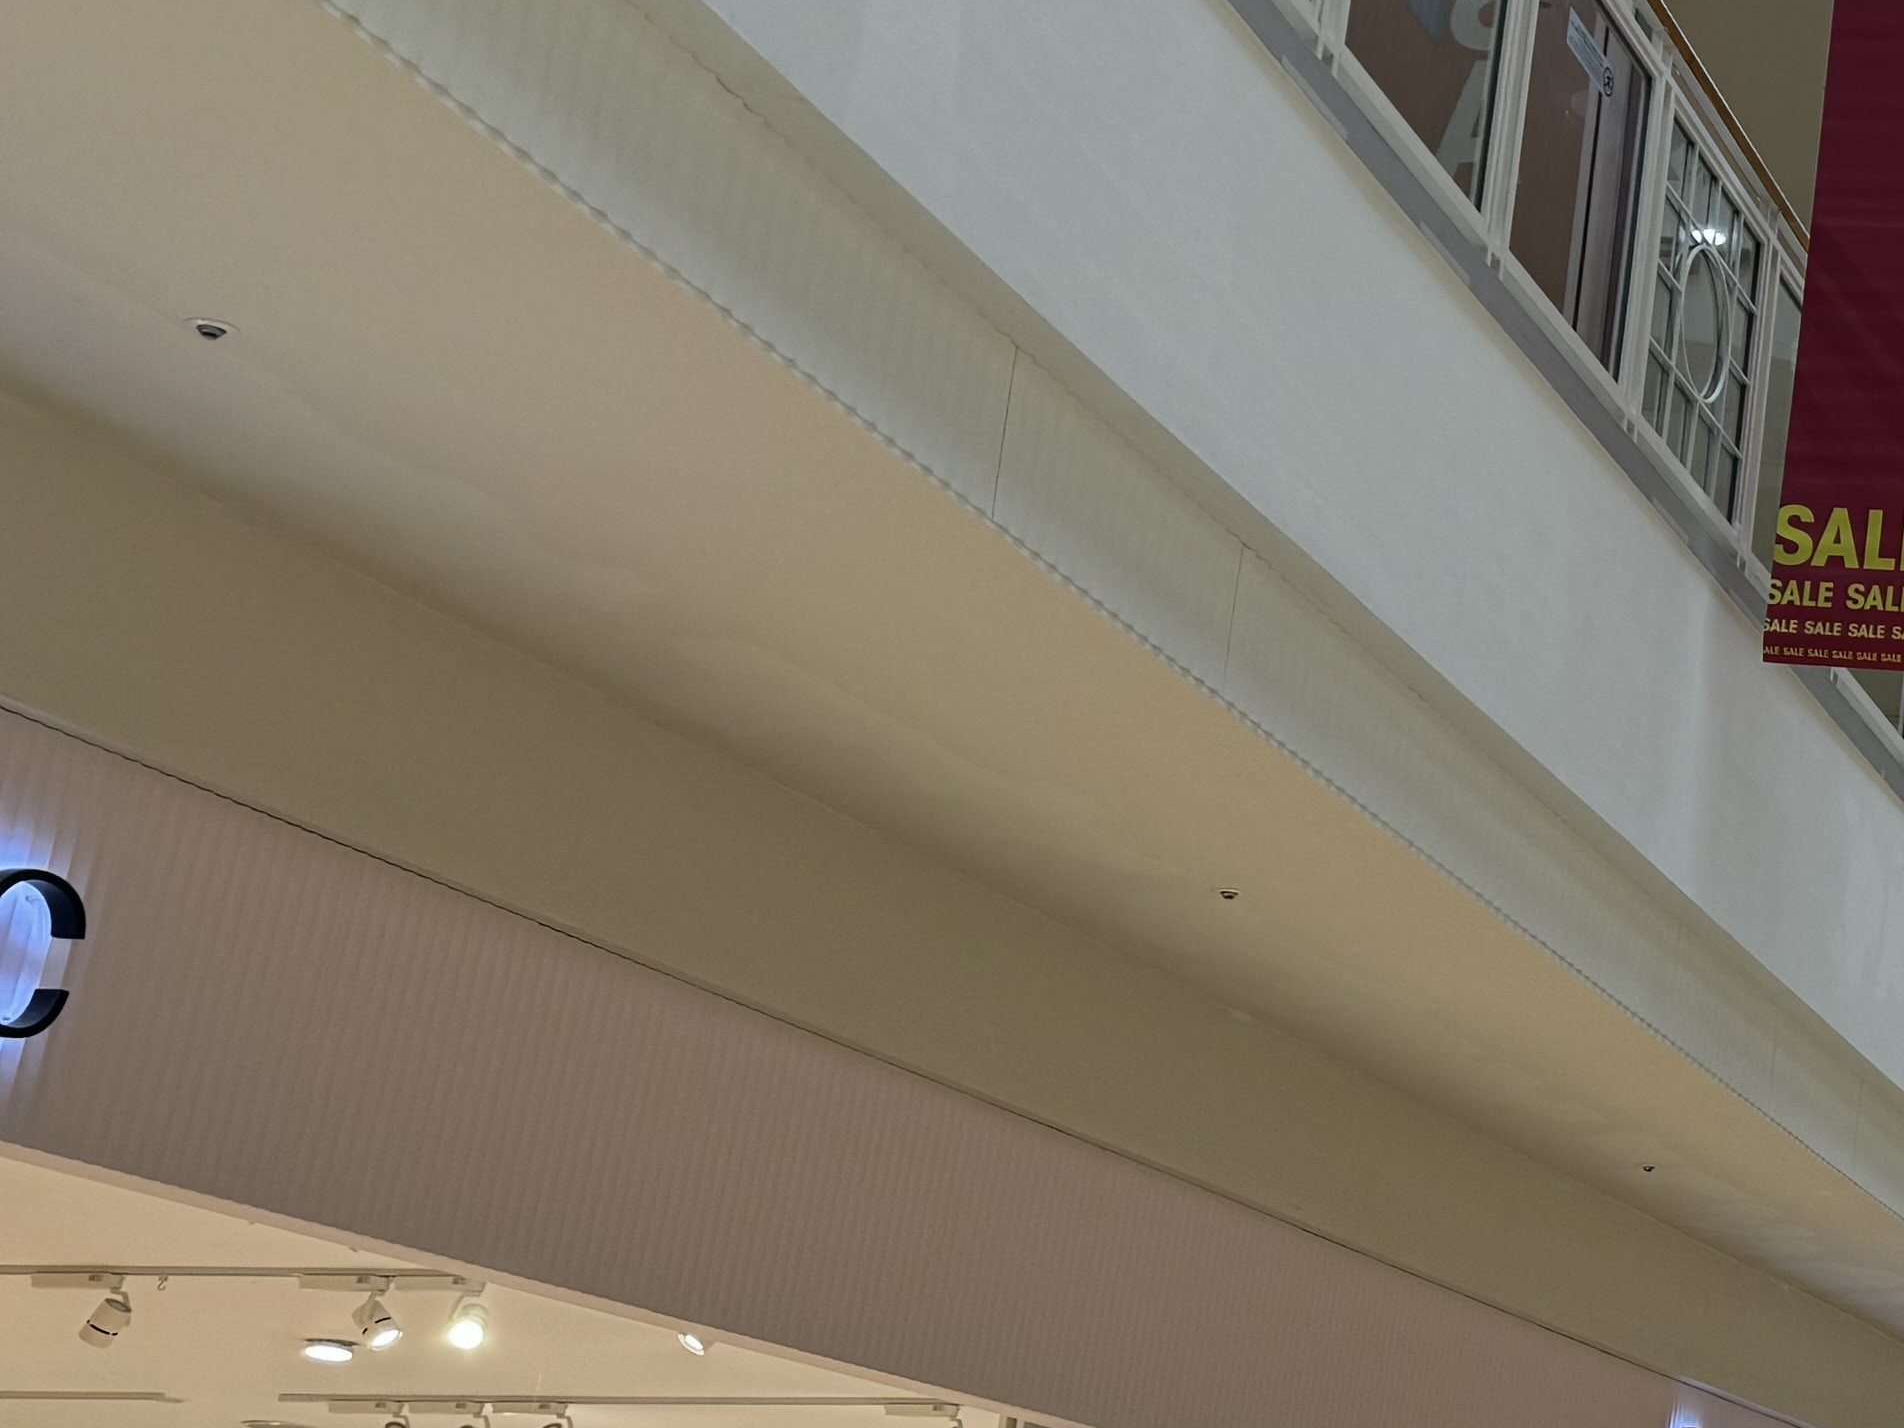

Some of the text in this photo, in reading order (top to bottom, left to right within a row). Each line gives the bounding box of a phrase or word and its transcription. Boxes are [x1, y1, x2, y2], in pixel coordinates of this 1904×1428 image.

[1770, 578, 1834, 608] SALE
[1804, 620, 1842, 636] SALE
[1847, 623, 1885, 639] SALE
